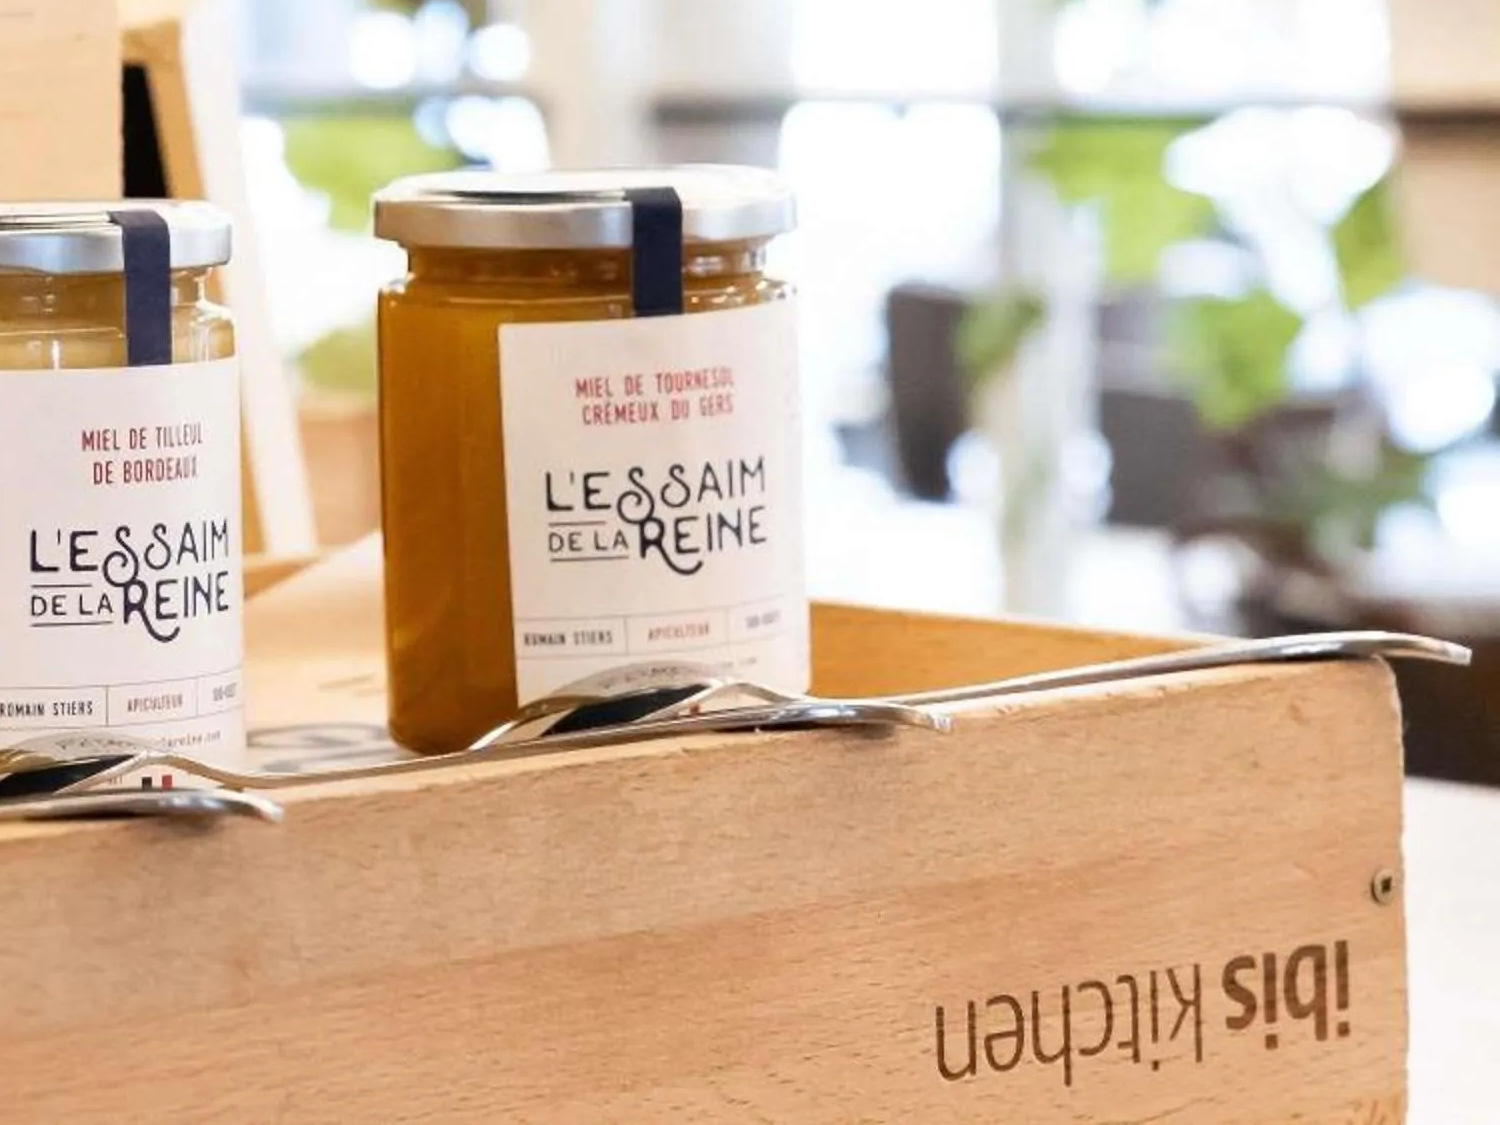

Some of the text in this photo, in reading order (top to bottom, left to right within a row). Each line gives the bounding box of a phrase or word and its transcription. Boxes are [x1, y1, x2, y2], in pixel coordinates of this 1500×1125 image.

[575, 366, 735, 398] MIEL DE TOURNESOL
[582, 393, 734, 425] CRÉMEUX DU GERS
[81, 422, 203, 452] MIEL DE TILLEUL
[93, 455, 198, 485] DE BORDEAUX
[545, 455, 766, 525] L'ESSAIM
[30, 517, 230, 587] L'ESSAIM
[548, 505, 768, 575] DE LA REINE
[30, 571, 230, 643] DE LA REINE
[523, 632, 567, 647] ROMAIN
[52, 700, 94, 716] STIERS
[126, 693, 184, 713] APICULTEUR
[934, 940, 1351, 1087] ibis kitchen
